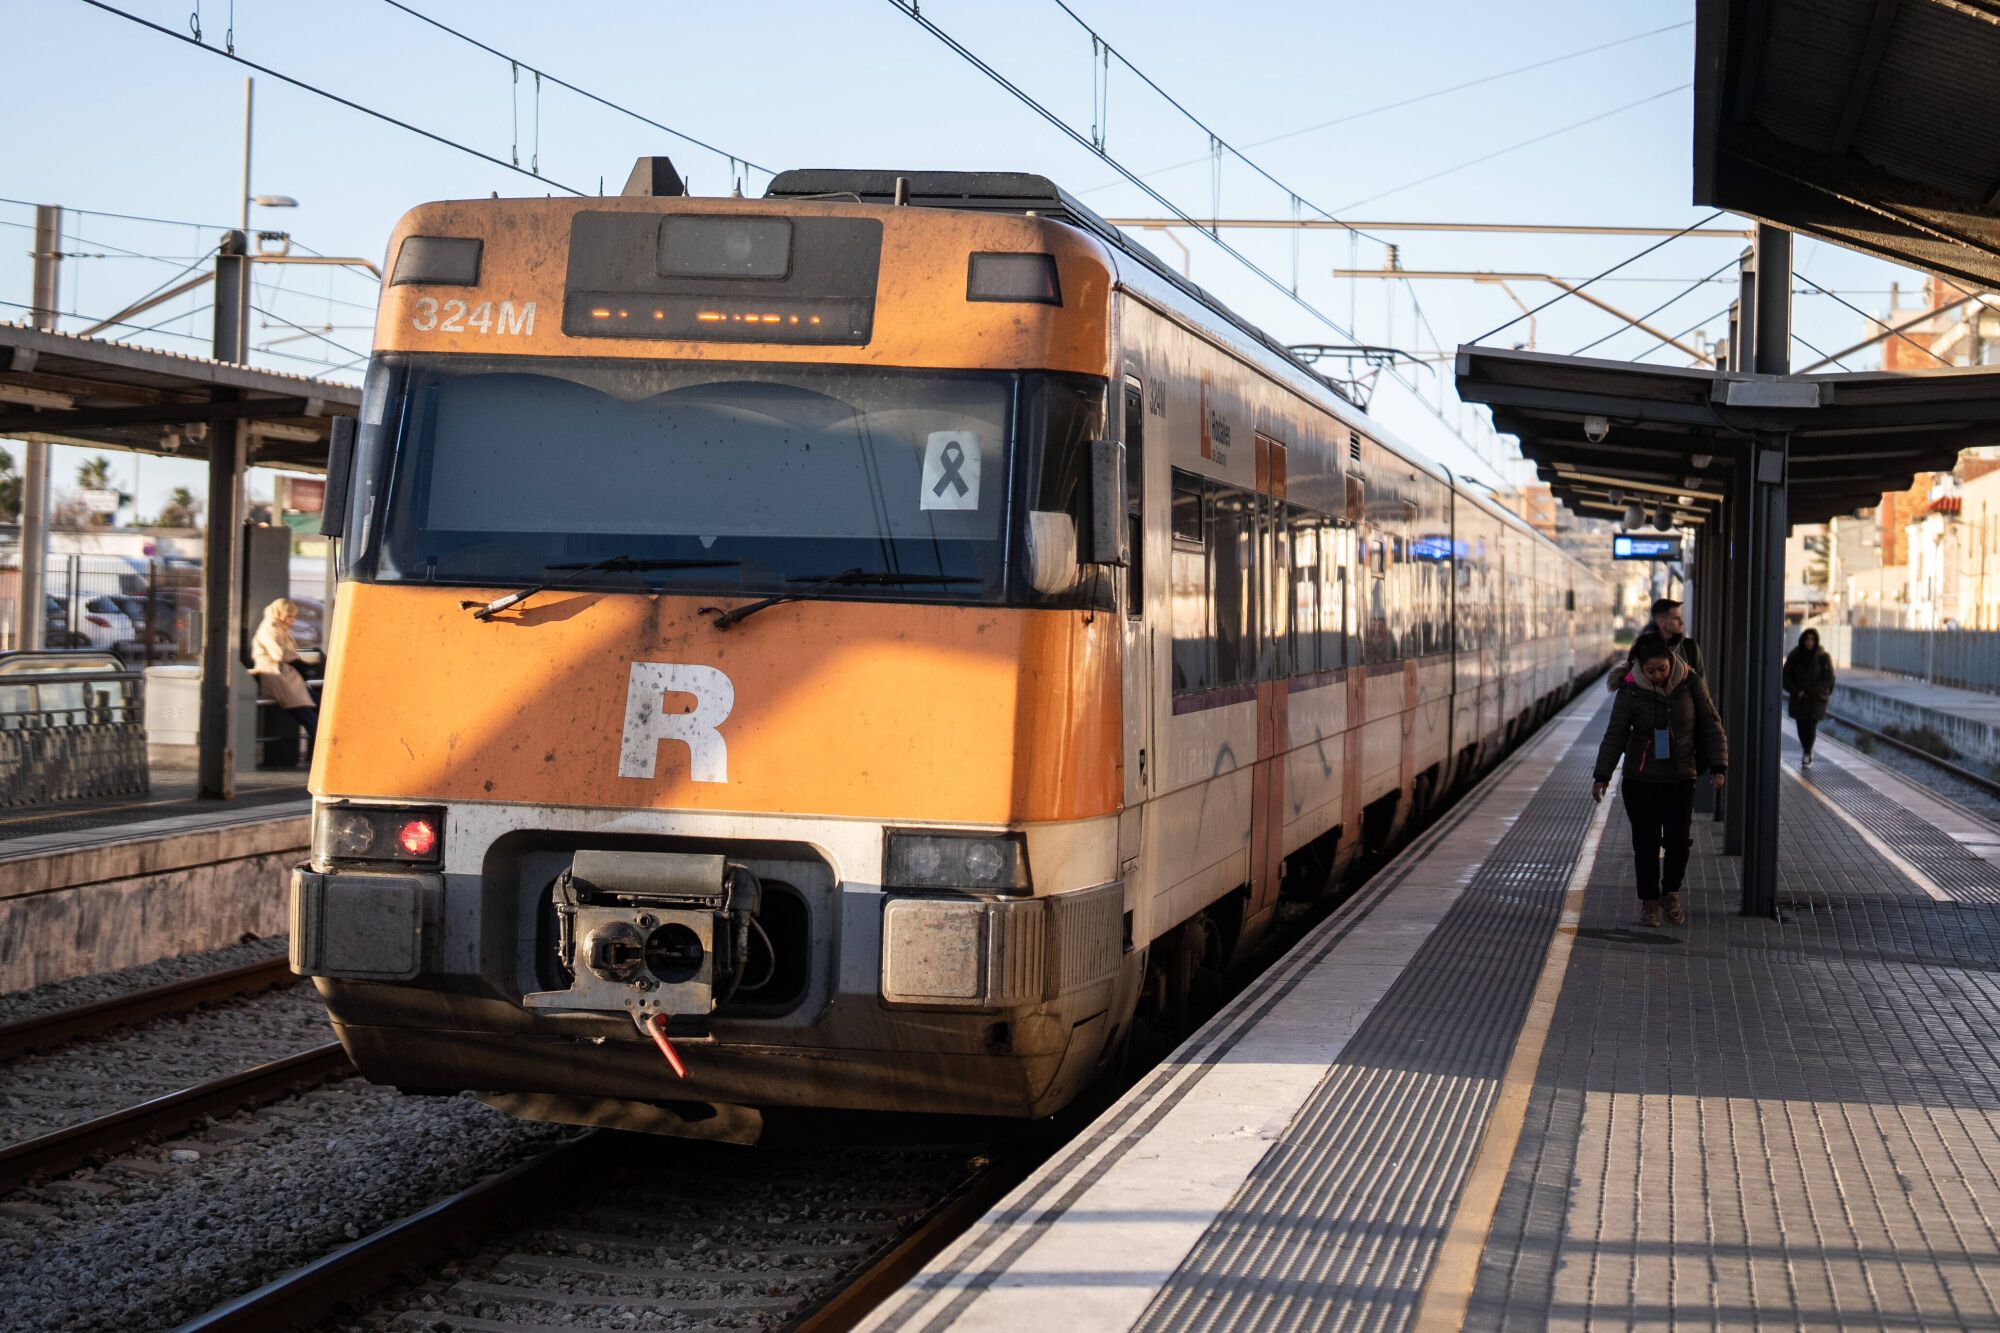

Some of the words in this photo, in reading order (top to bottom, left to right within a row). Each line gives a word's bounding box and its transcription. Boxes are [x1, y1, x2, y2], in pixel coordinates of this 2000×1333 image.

[412, 296, 537, 336] 324M
[1149, 376, 1166, 419] 324M
[617, 661, 736, 784] R
